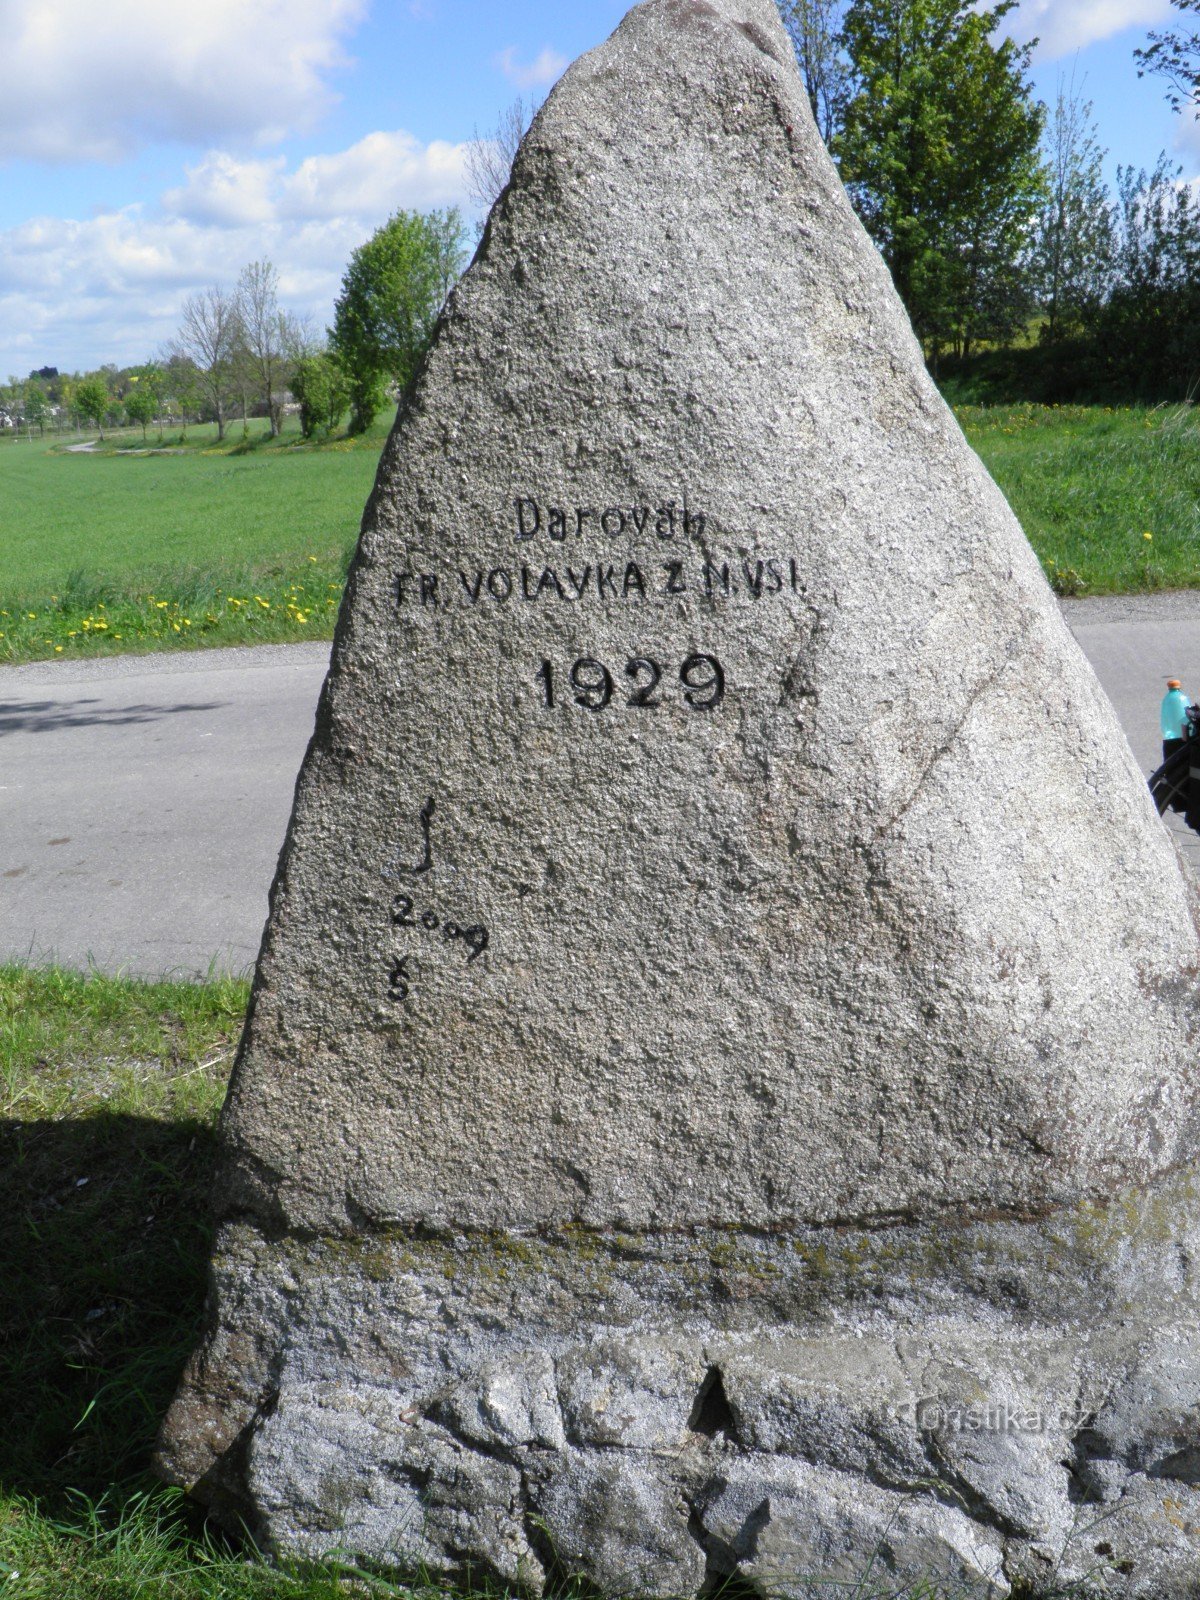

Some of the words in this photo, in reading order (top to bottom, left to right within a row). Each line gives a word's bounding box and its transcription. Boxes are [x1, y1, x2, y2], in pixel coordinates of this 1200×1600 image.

[459, 561, 647, 604] VOLAVKA
[662, 561, 687, 594] Z
[536, 654, 725, 710] 1929
